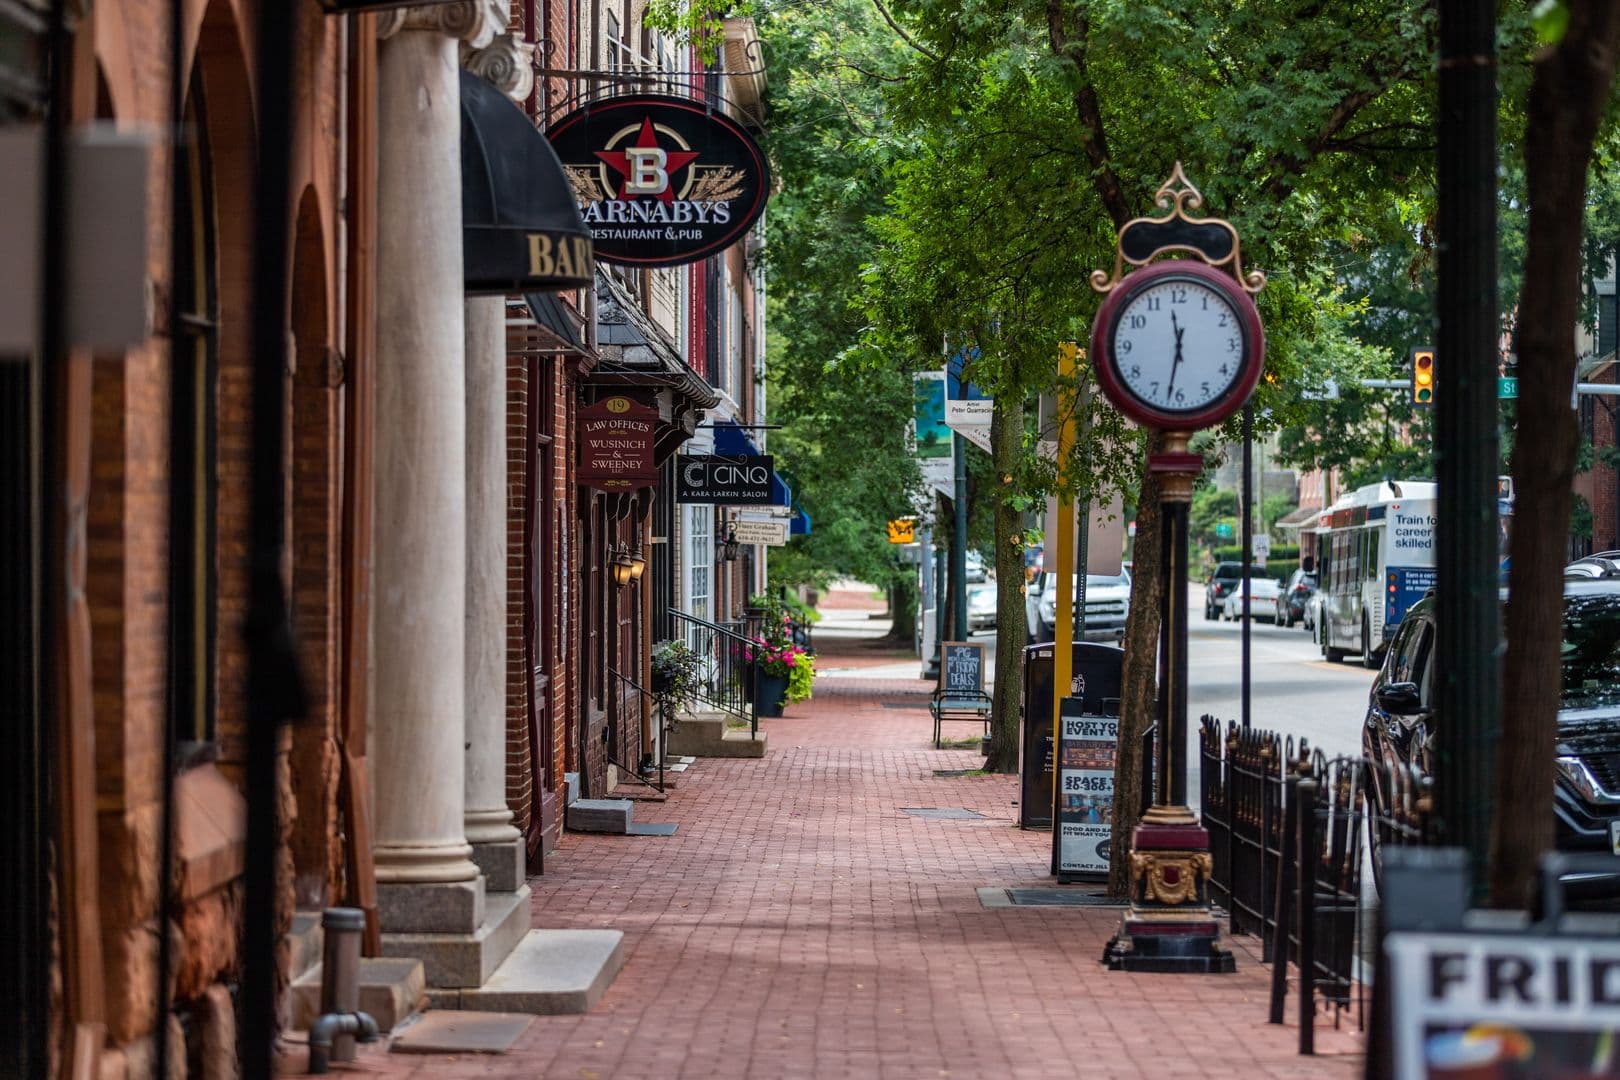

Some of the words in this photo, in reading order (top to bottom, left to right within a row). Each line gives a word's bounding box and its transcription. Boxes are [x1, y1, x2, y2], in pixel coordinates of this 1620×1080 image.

[625, 147, 668, 194] B
[665, 227, 677, 240] &
[680, 230, 702, 239] PUB
[1171, 290, 1187, 304] 12
[1202, 297, 1208, 310] 1
[1147, 297, 1160, 311] 11
[1131, 314, 1146, 329] 10
[1218, 313, 1228, 327] 2
[1123, 340, 1132, 353] 9
[1227, 339, 1236, 352] 3
[1131, 366, 1140, 379] 8
[1219, 363, 1228, 376] 4
[1150, 382, 1159, 395] 7
[1201, 382, 1210, 395] 5
[1503, 382, 1515, 393] St
[1176, 389, 1185, 401] 6
[586, 420, 607, 432] LAW
[609, 420, 650, 433] OFFICES
[589, 440, 646, 449] WUSINICH
[613, 450, 622, 459] &
[592, 460, 643, 469] SWEENEY
[714, 466, 768, 485] CINQ
[742, 490, 768, 498] SALON
[1395, 514, 1424, 525] Train
[1395, 529, 1432, 537] career
[1395, 538, 1432, 549] skilled
[951, 672, 976, 686] DEALS
[1066, 721, 1098, 729] HOST
[1066, 728, 1105, 736] EVENT
[1065, 776, 1106, 785] SPACE
[1065, 783, 1112, 791] 20-300+
